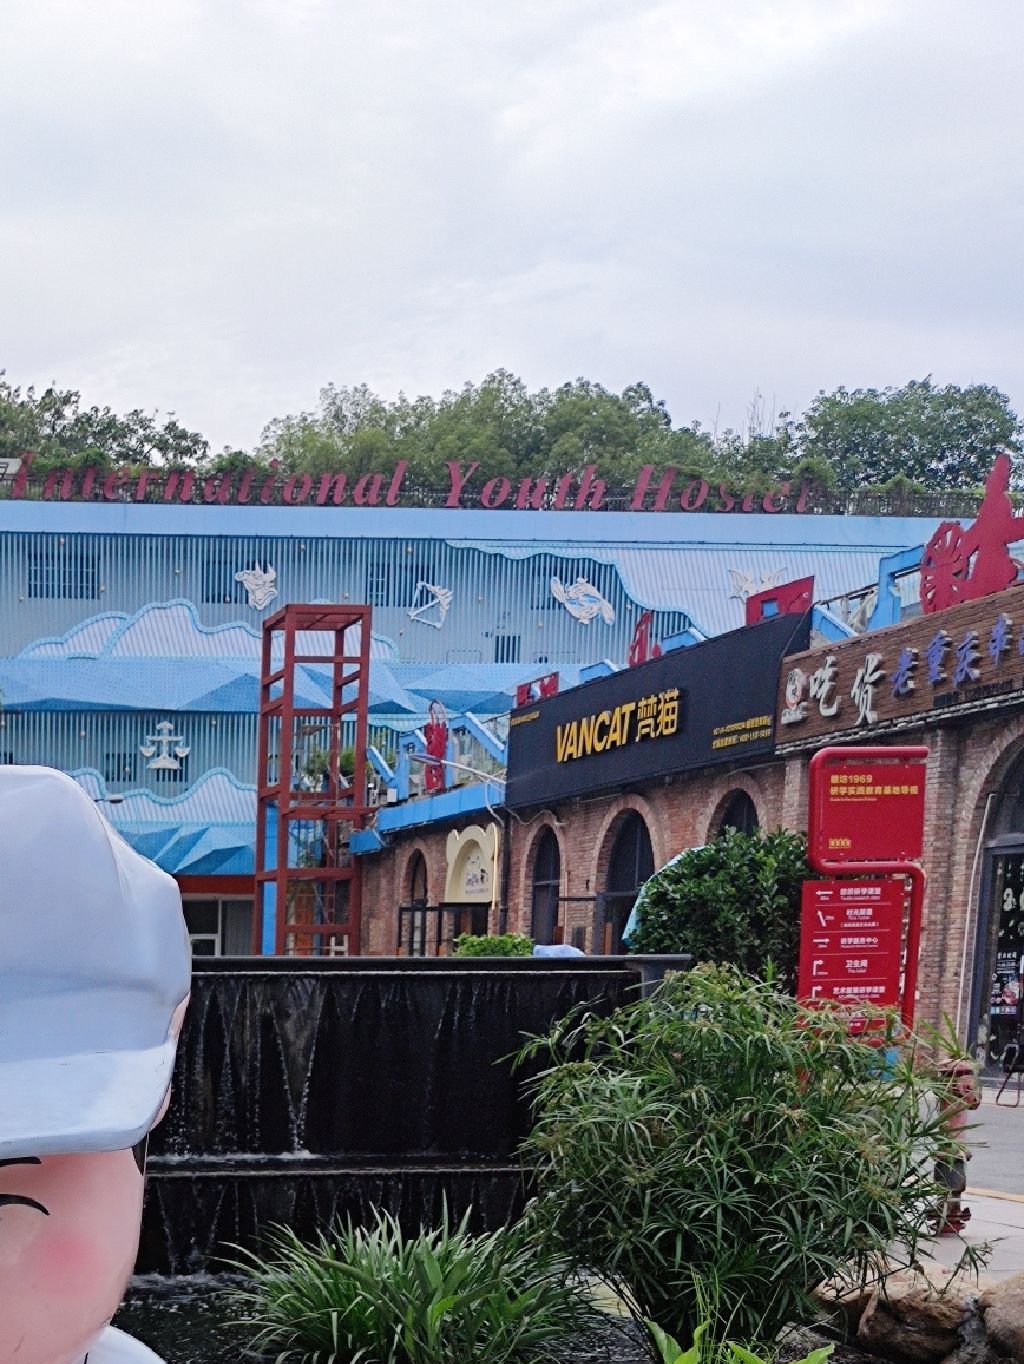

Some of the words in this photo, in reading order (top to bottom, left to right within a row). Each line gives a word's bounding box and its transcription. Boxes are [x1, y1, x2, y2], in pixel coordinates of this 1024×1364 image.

[442, 460, 608, 512] Youth
[555, 701, 636, 763] VANCAT
[635, 688, 680, 743] 梵猫
